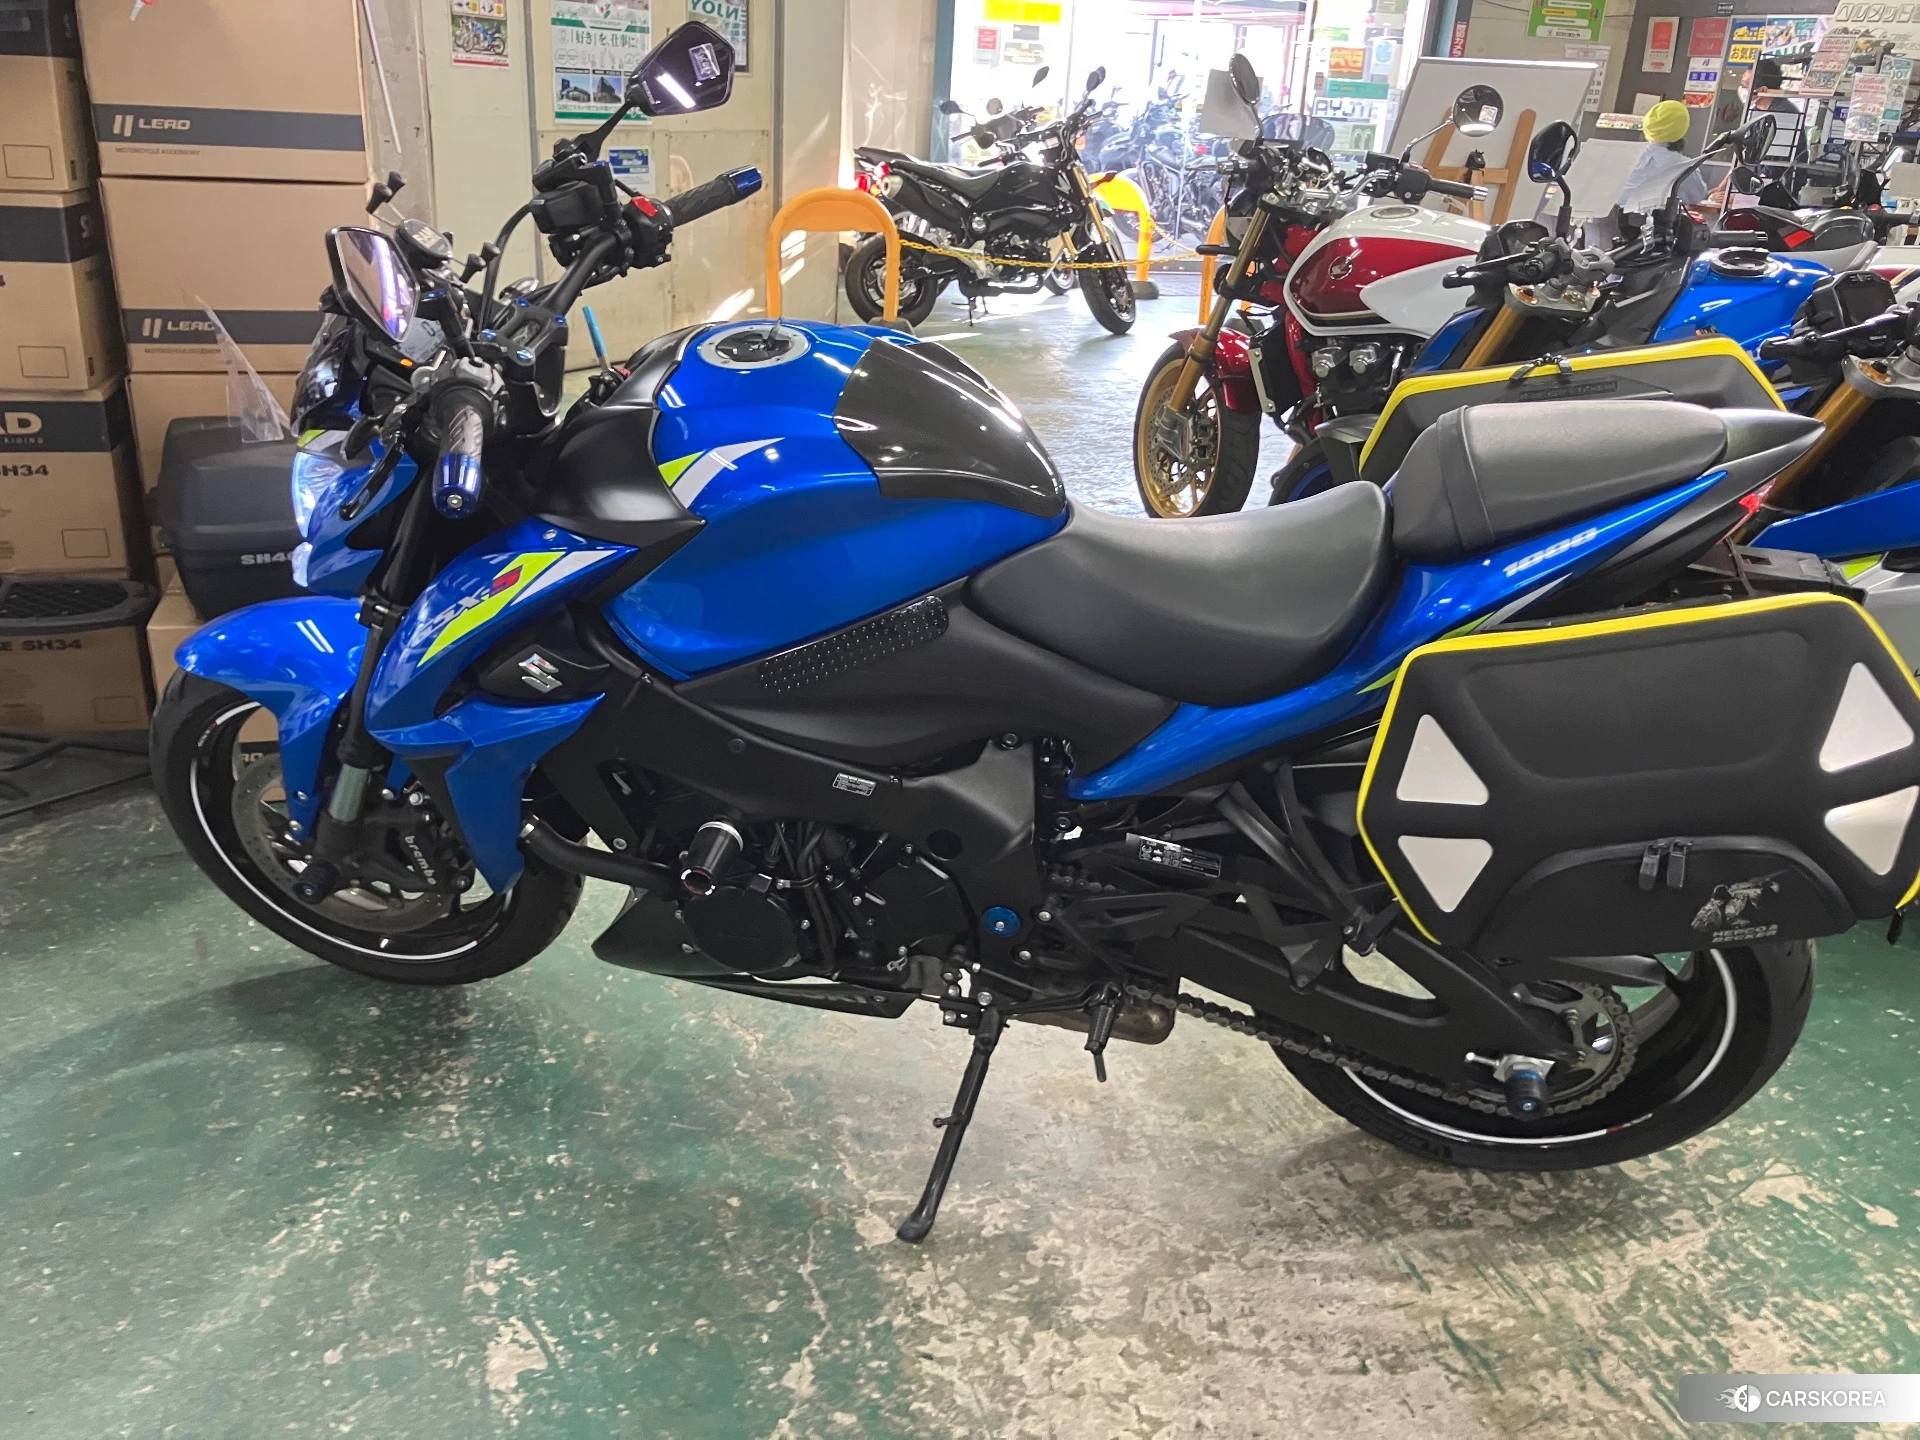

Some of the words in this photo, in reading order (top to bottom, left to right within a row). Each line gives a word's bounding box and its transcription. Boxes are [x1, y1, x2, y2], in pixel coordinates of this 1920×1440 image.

[138, 118, 191, 130] LEAD
[0, 464, 49, 477] H34
[22, 639, 83, 652] SH34
[404, 835, 437, 885] brembo
